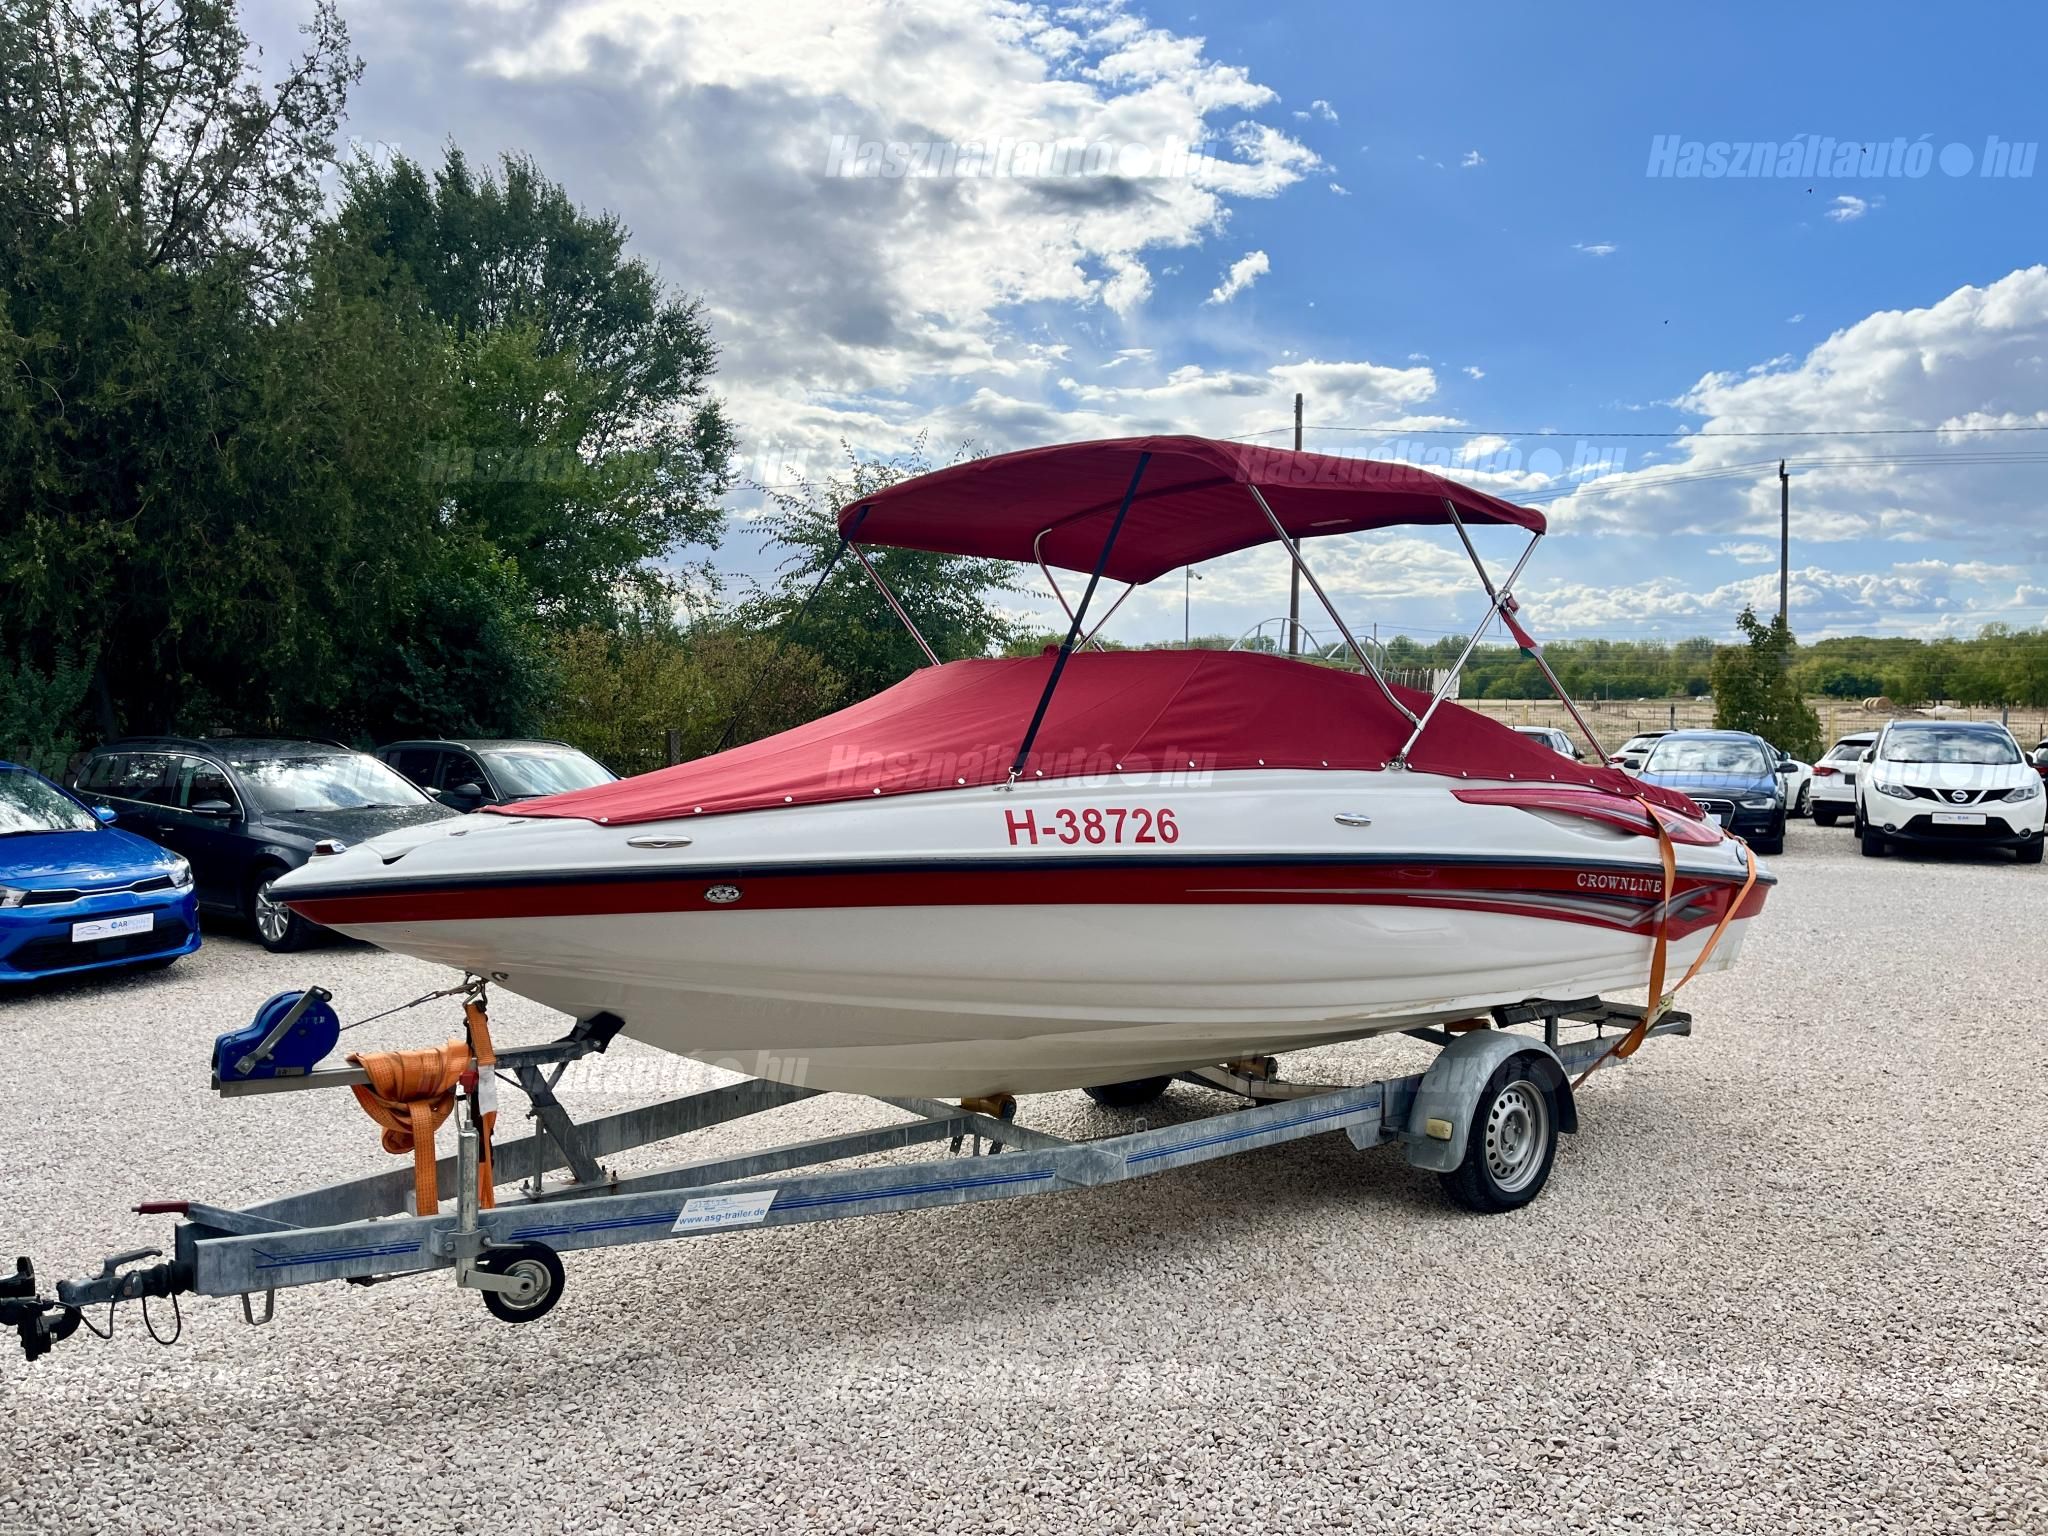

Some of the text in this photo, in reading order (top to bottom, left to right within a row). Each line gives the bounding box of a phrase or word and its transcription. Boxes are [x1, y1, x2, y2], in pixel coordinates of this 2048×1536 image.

[1004, 808, 1179, 845] H-38726
[1577, 873, 1662, 893] CROWNLINE
[679, 1208, 765, 1225] www.asg-trailer.de
